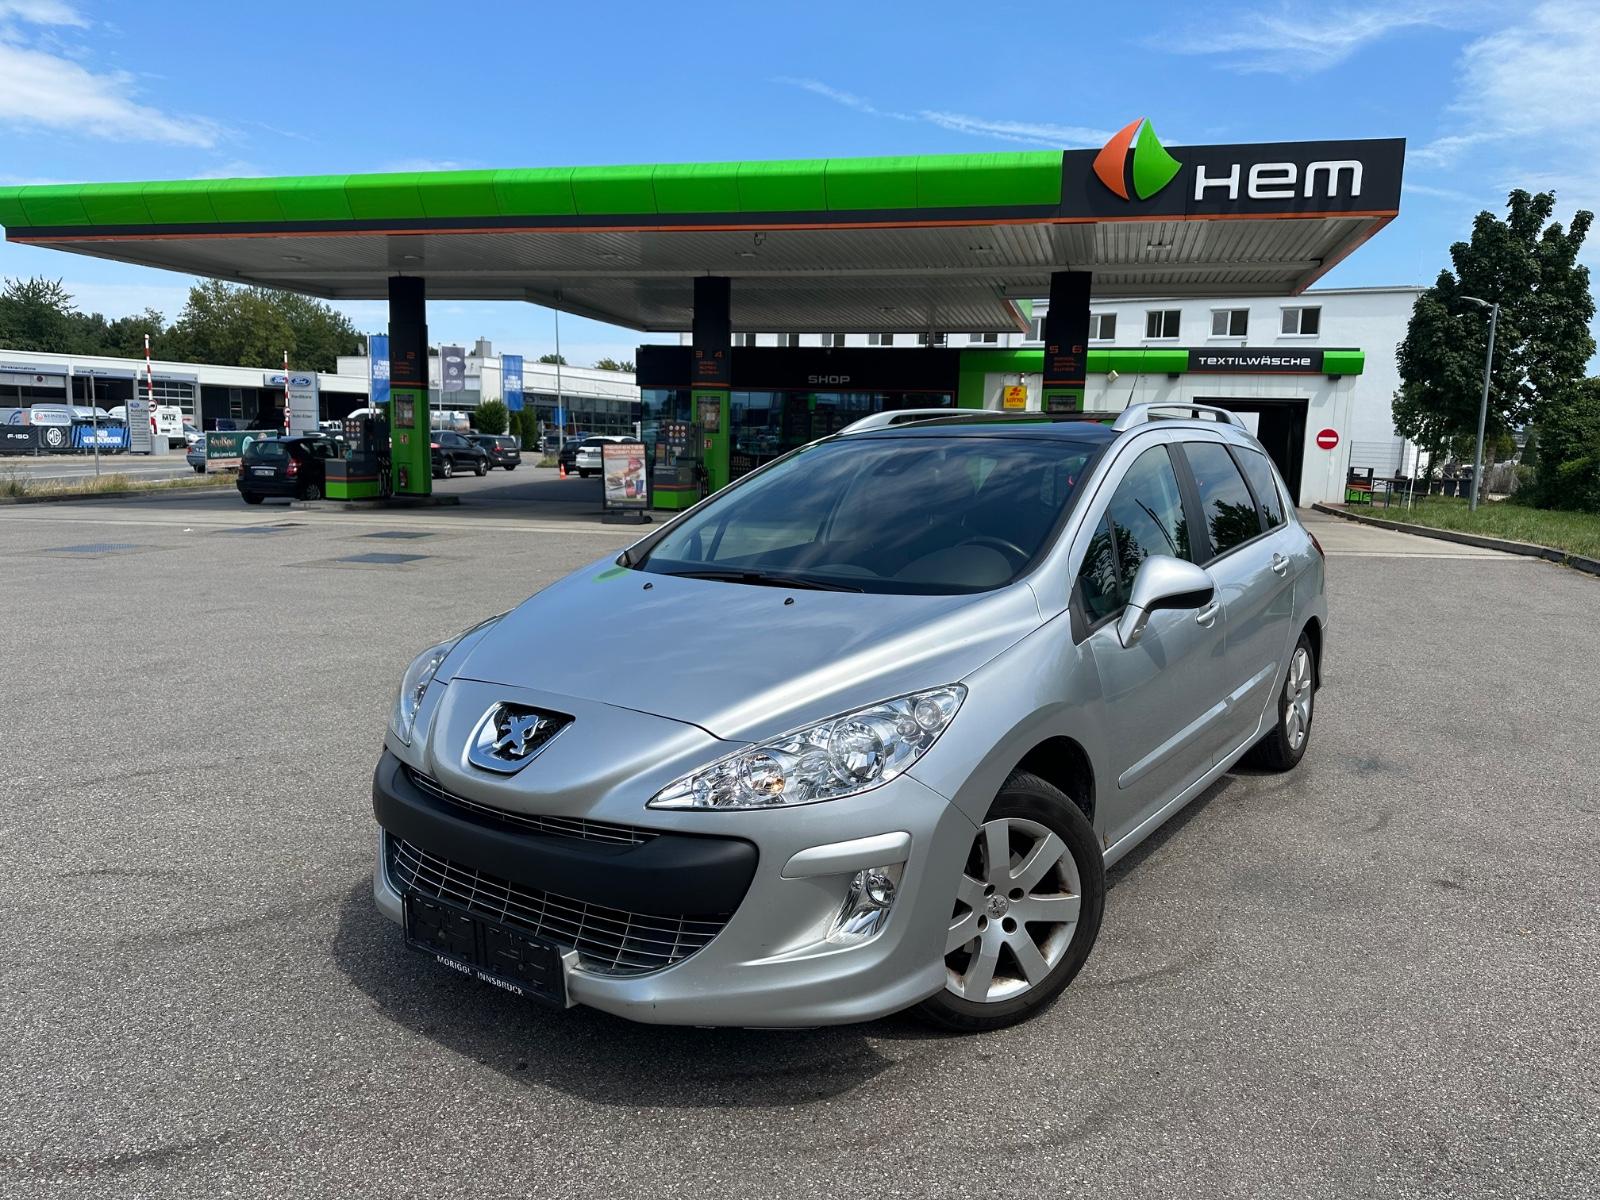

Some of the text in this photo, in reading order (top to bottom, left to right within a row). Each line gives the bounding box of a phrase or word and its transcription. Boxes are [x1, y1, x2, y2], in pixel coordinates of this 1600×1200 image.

[1049, 344, 1083, 353] 5 6
[807, 375, 851, 384] SHOP
[477, 971, 524, 997] INNSBRUCK
